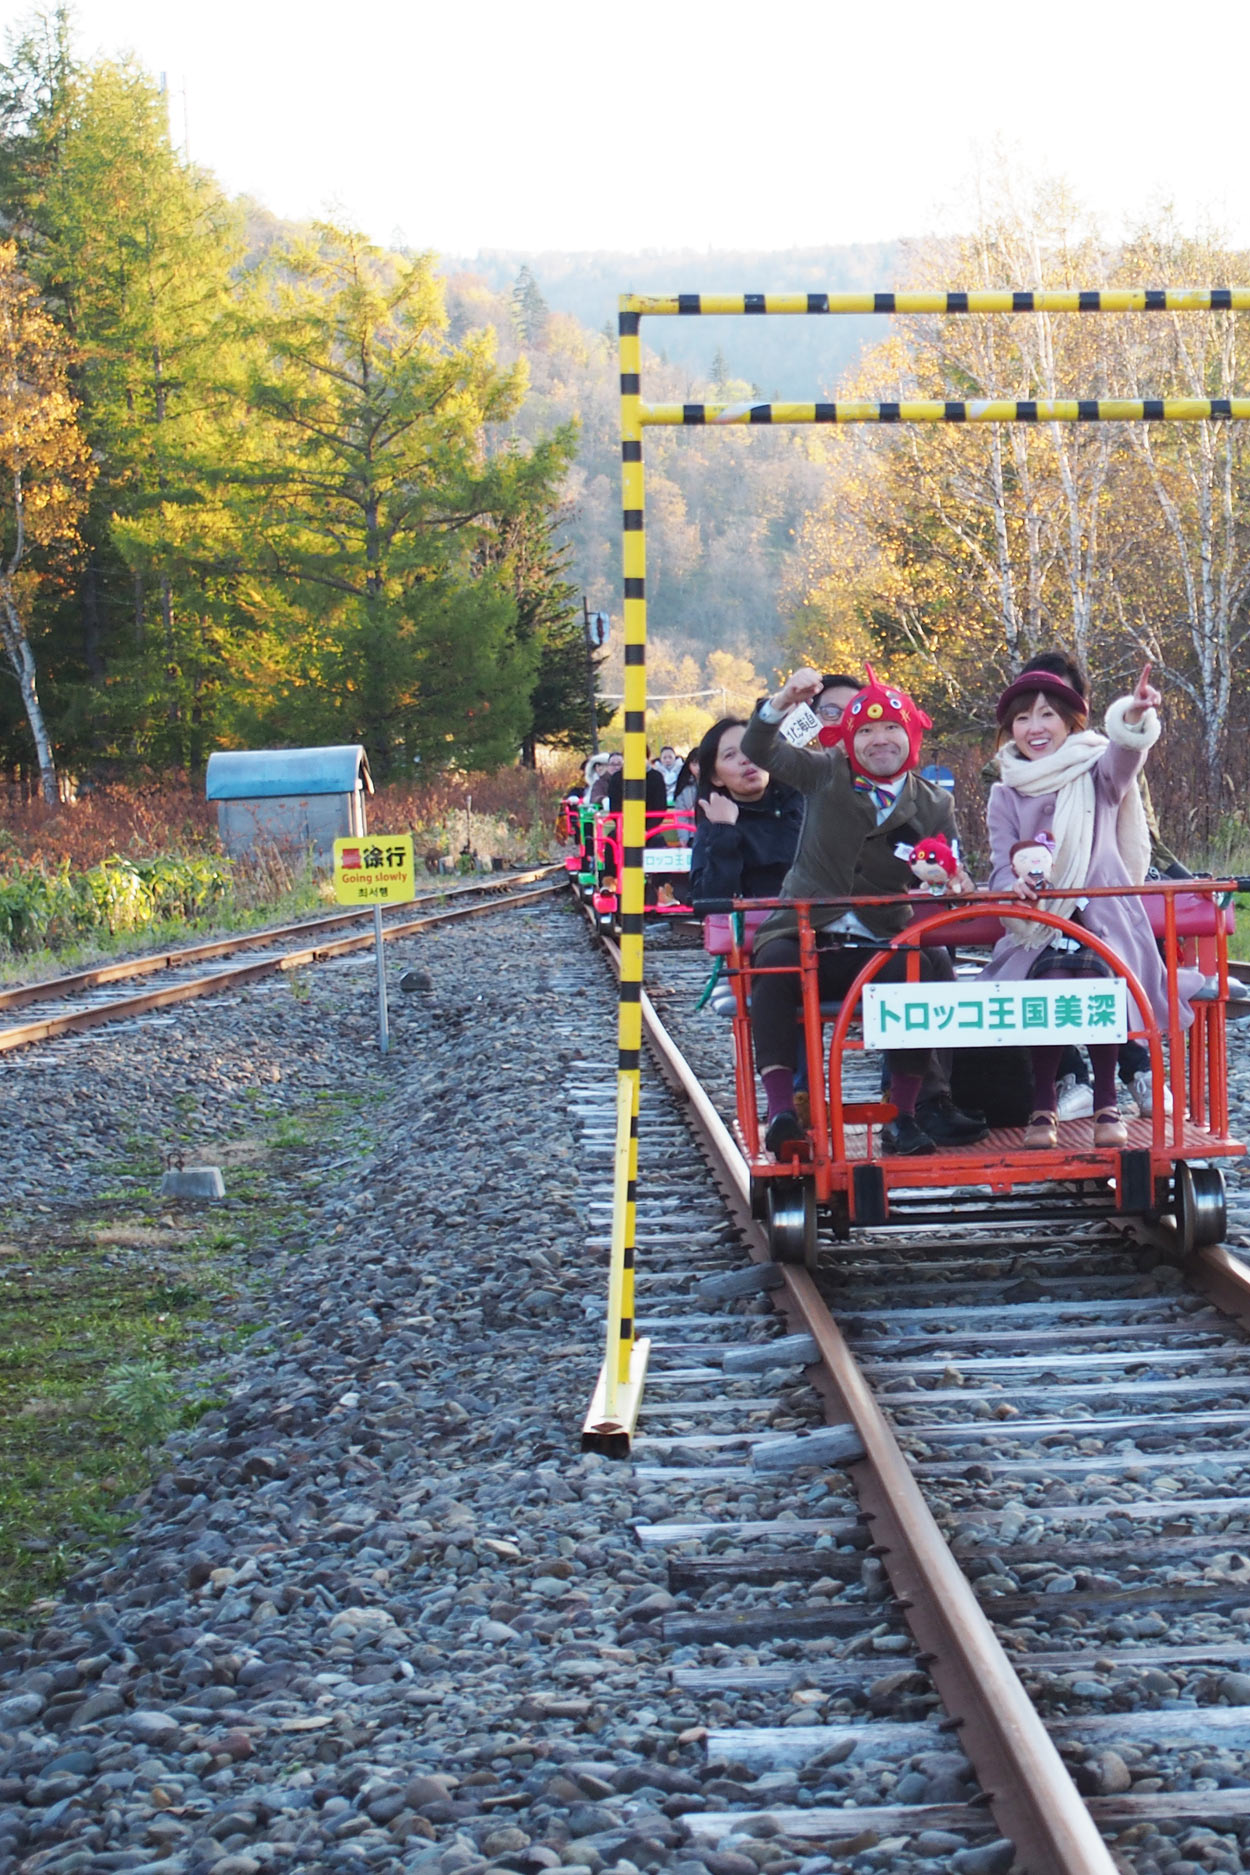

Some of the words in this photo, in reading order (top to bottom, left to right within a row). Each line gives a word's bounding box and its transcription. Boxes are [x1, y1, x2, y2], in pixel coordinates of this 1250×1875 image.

[787, 712, 818, 742] 北海道
[342, 873, 372, 884] Going
[375, 871, 407, 883] slowly
[880, 994, 1116, 1032] トロッコ王国美深
